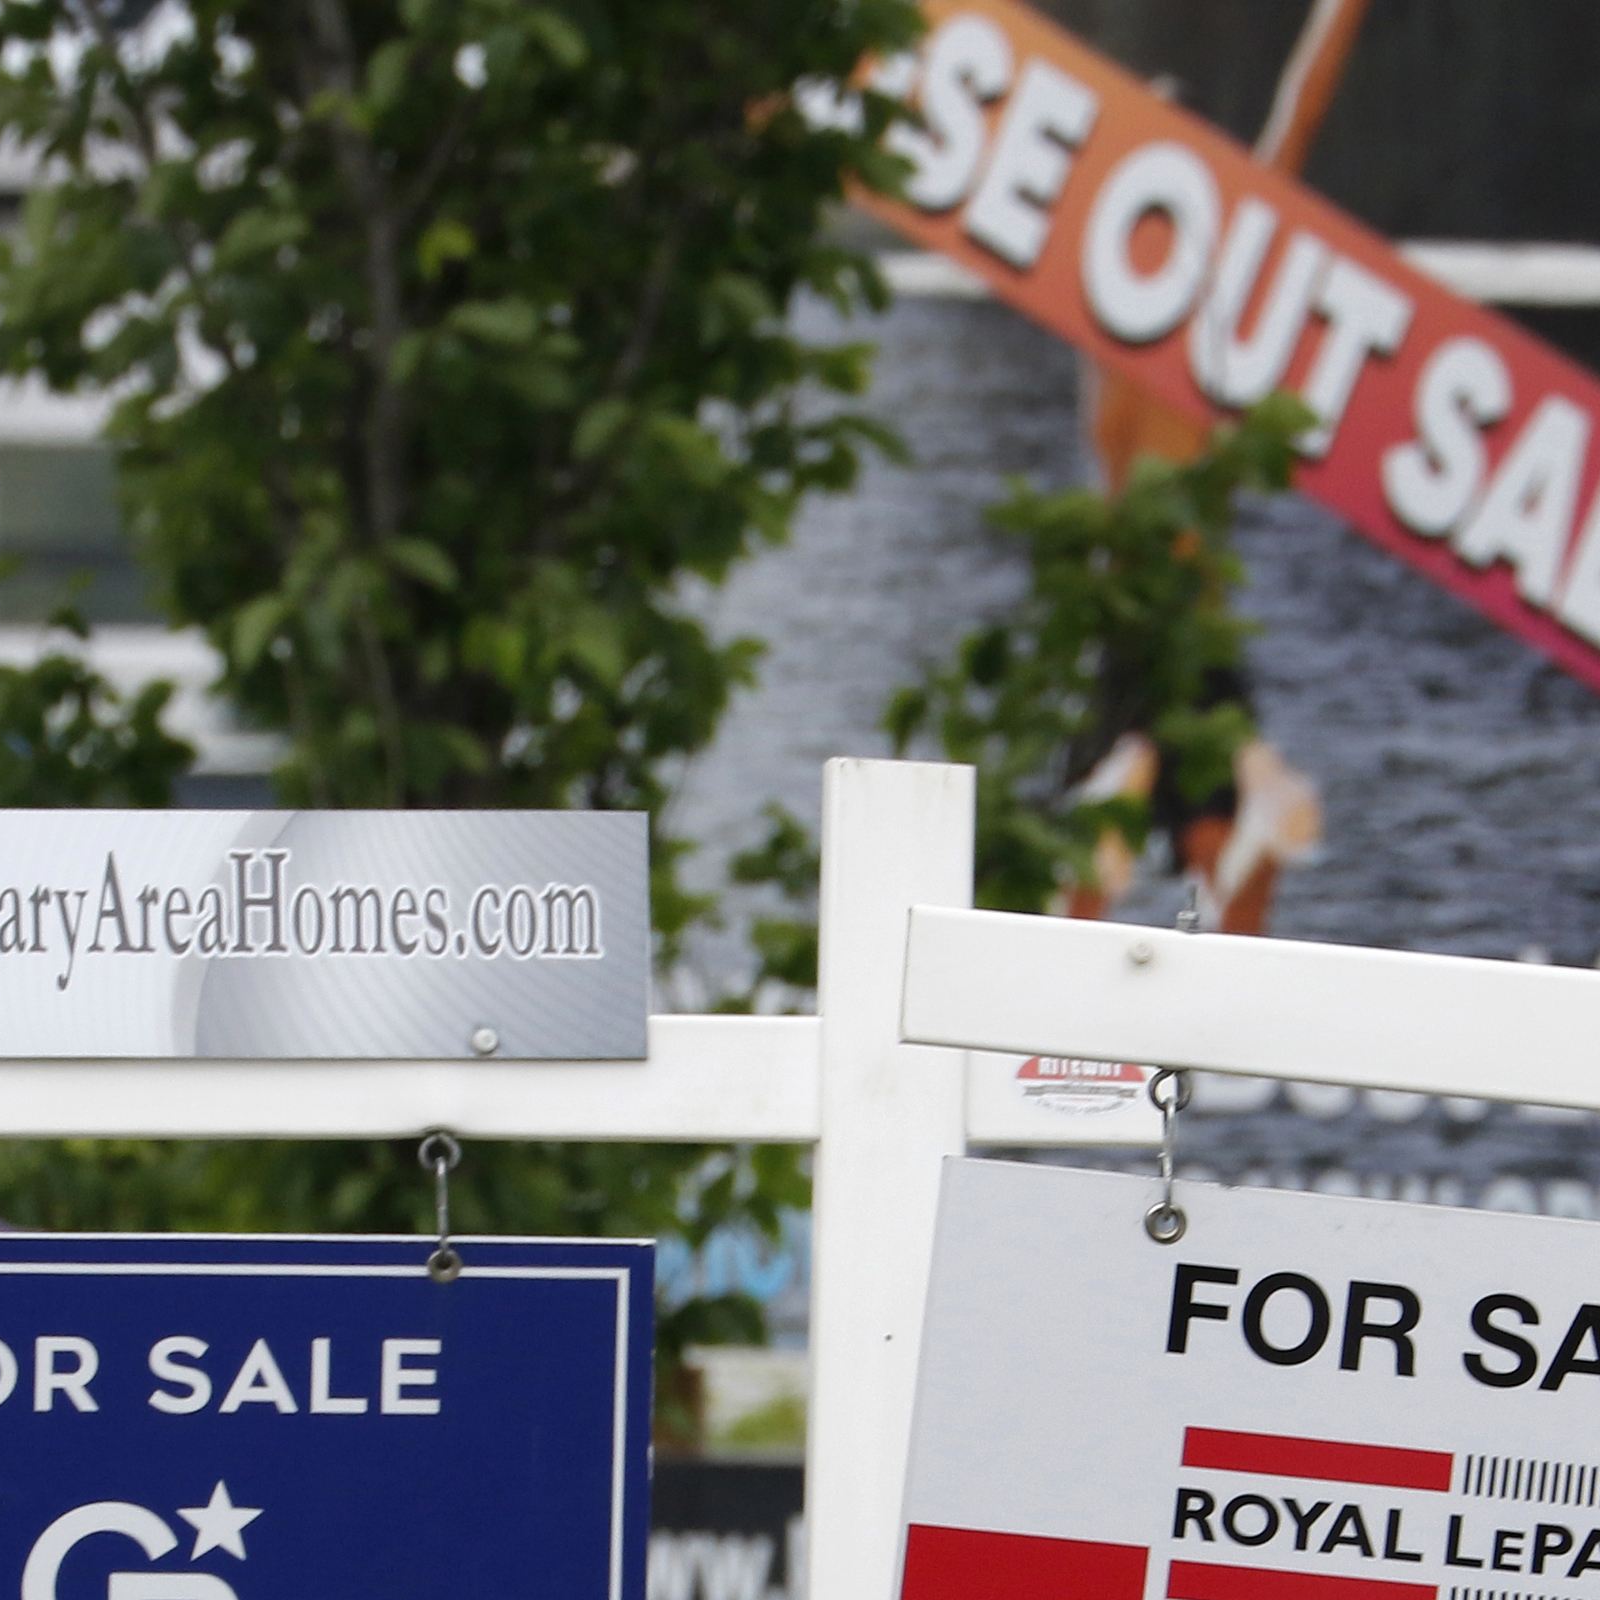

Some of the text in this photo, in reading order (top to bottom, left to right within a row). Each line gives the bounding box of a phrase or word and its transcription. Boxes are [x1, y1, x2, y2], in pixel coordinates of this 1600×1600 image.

[1081, 140, 1414, 460] OUT
[1166, 1262, 1421, 1377] FOR
[148, 1336, 442, 1415] SALE
[1171, 1487, 1424, 1564] ROYAL
